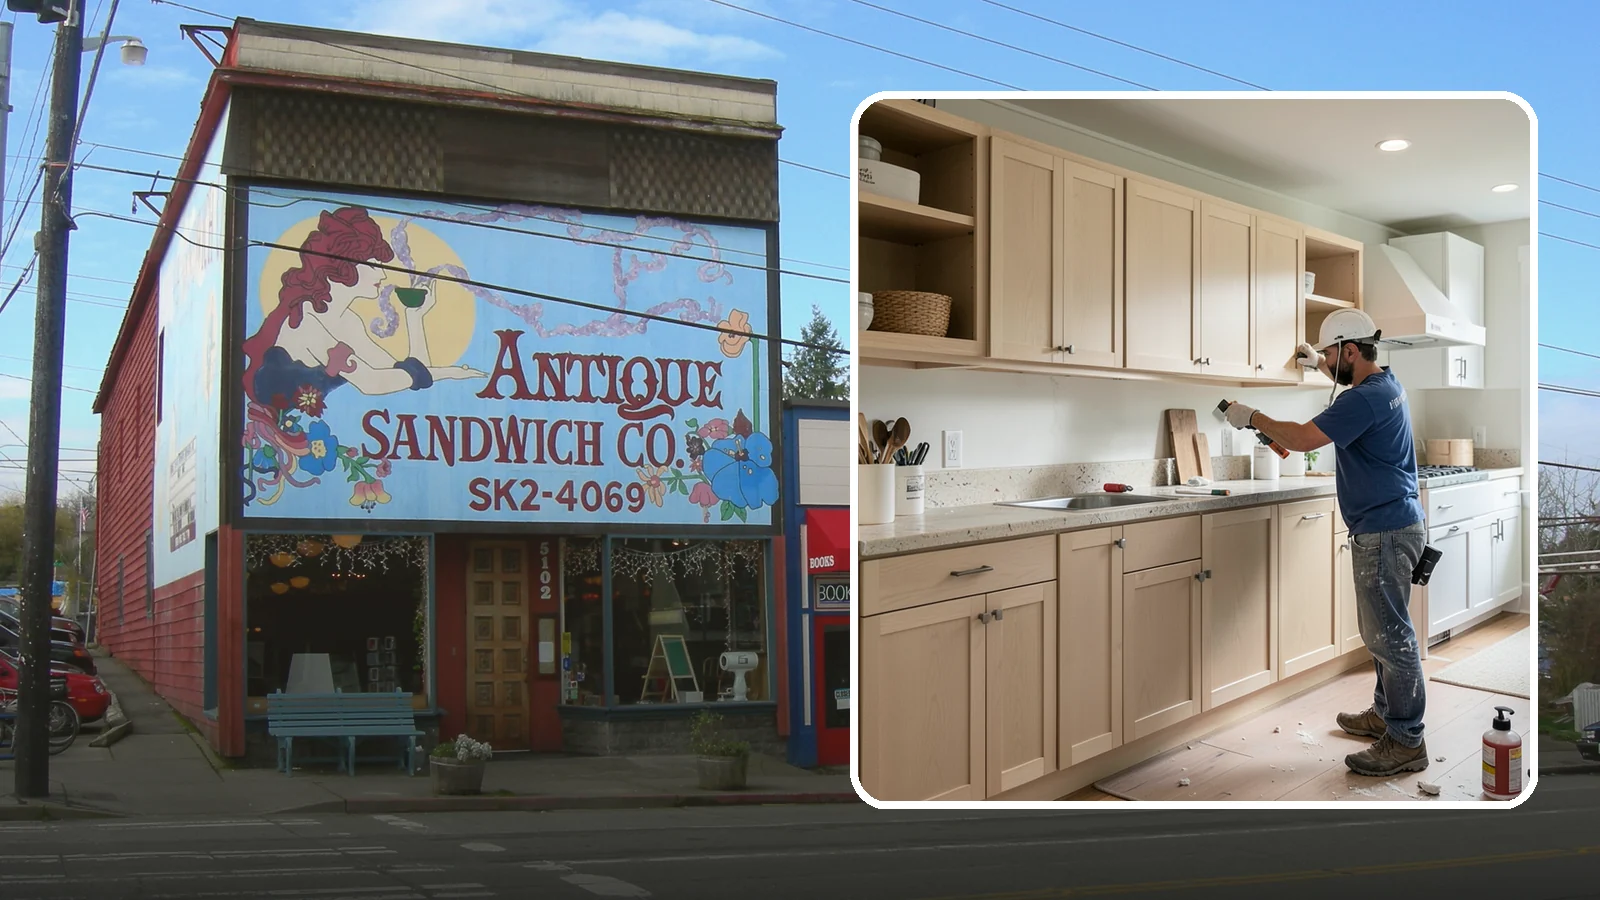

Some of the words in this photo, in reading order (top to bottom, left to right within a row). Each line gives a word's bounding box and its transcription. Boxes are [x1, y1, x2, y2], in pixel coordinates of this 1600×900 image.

[475, 328, 725, 420] ANTIQUE
[361, 407, 605, 468] SANDWICH
[617, 421, 686, 469] CO.
[468, 477, 647, 513] SK2-4069
[540, 541, 551, 600] 5102
[809, 555, 835, 569] BOOKS
